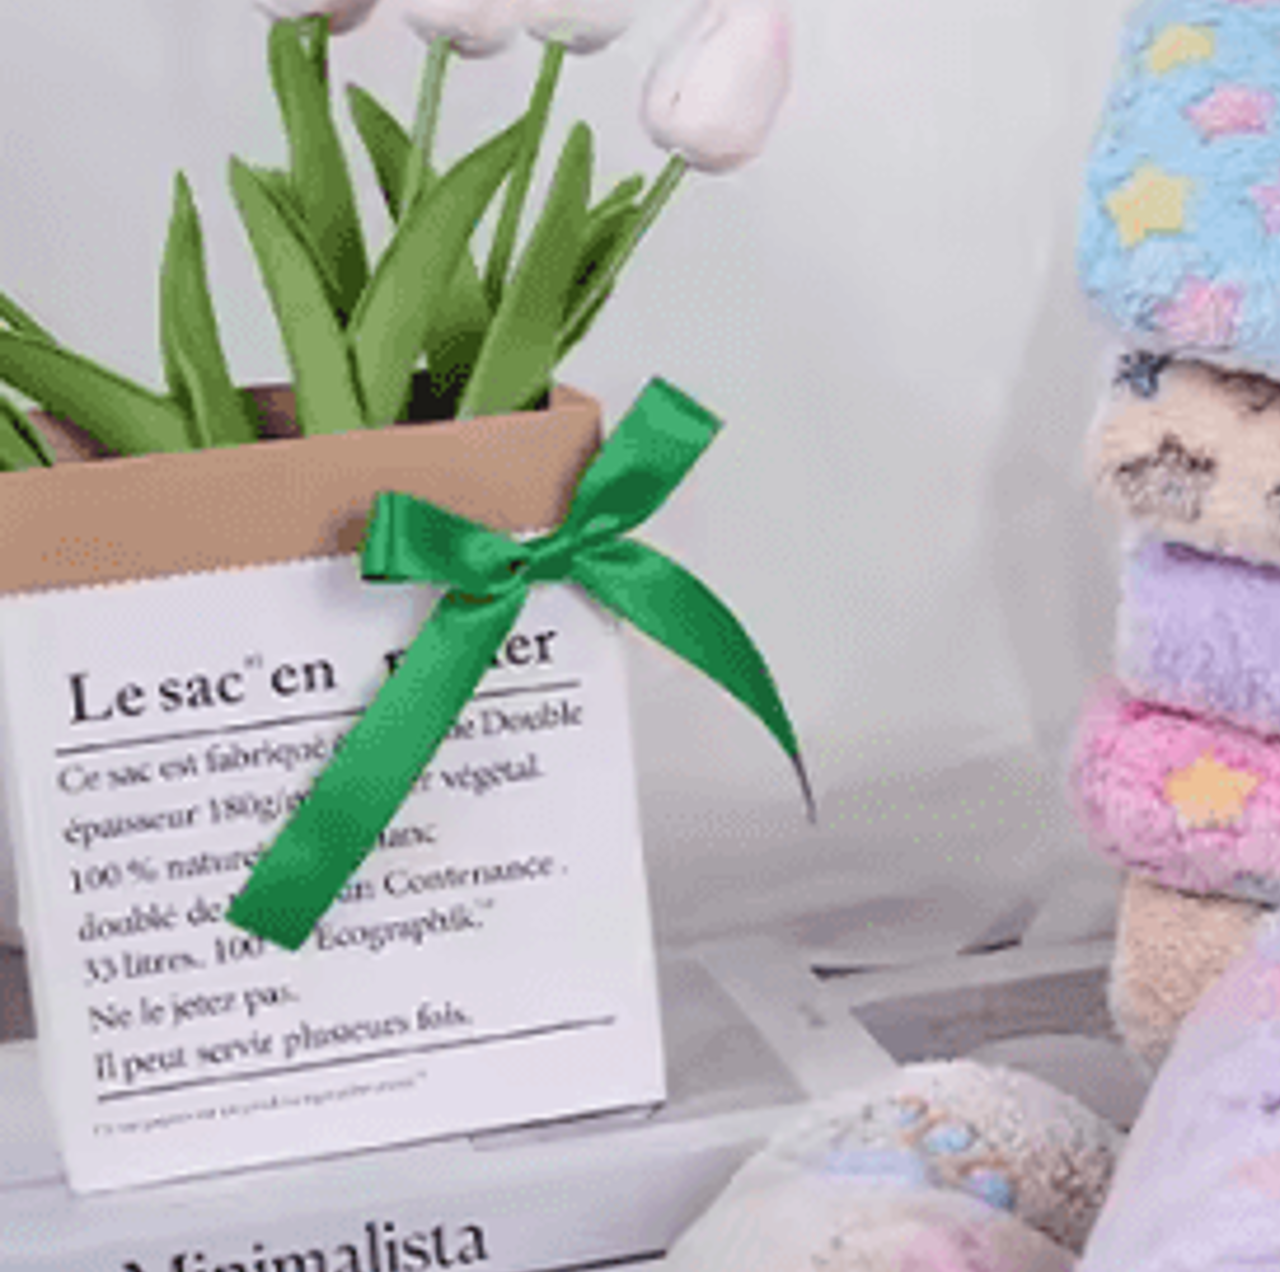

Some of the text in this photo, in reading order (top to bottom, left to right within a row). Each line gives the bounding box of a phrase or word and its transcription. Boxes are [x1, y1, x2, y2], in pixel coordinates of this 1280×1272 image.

[68, 658, 337, 724] Le sac en
[481, 700, 582, 736] Double
[58, 764, 100, 795] Ce
[106, 762, 150, 788] sac
[69, 865, 122, 894] 100
[88, 1002, 132, 1032] Ne
[140, 996, 165, 1025] le
